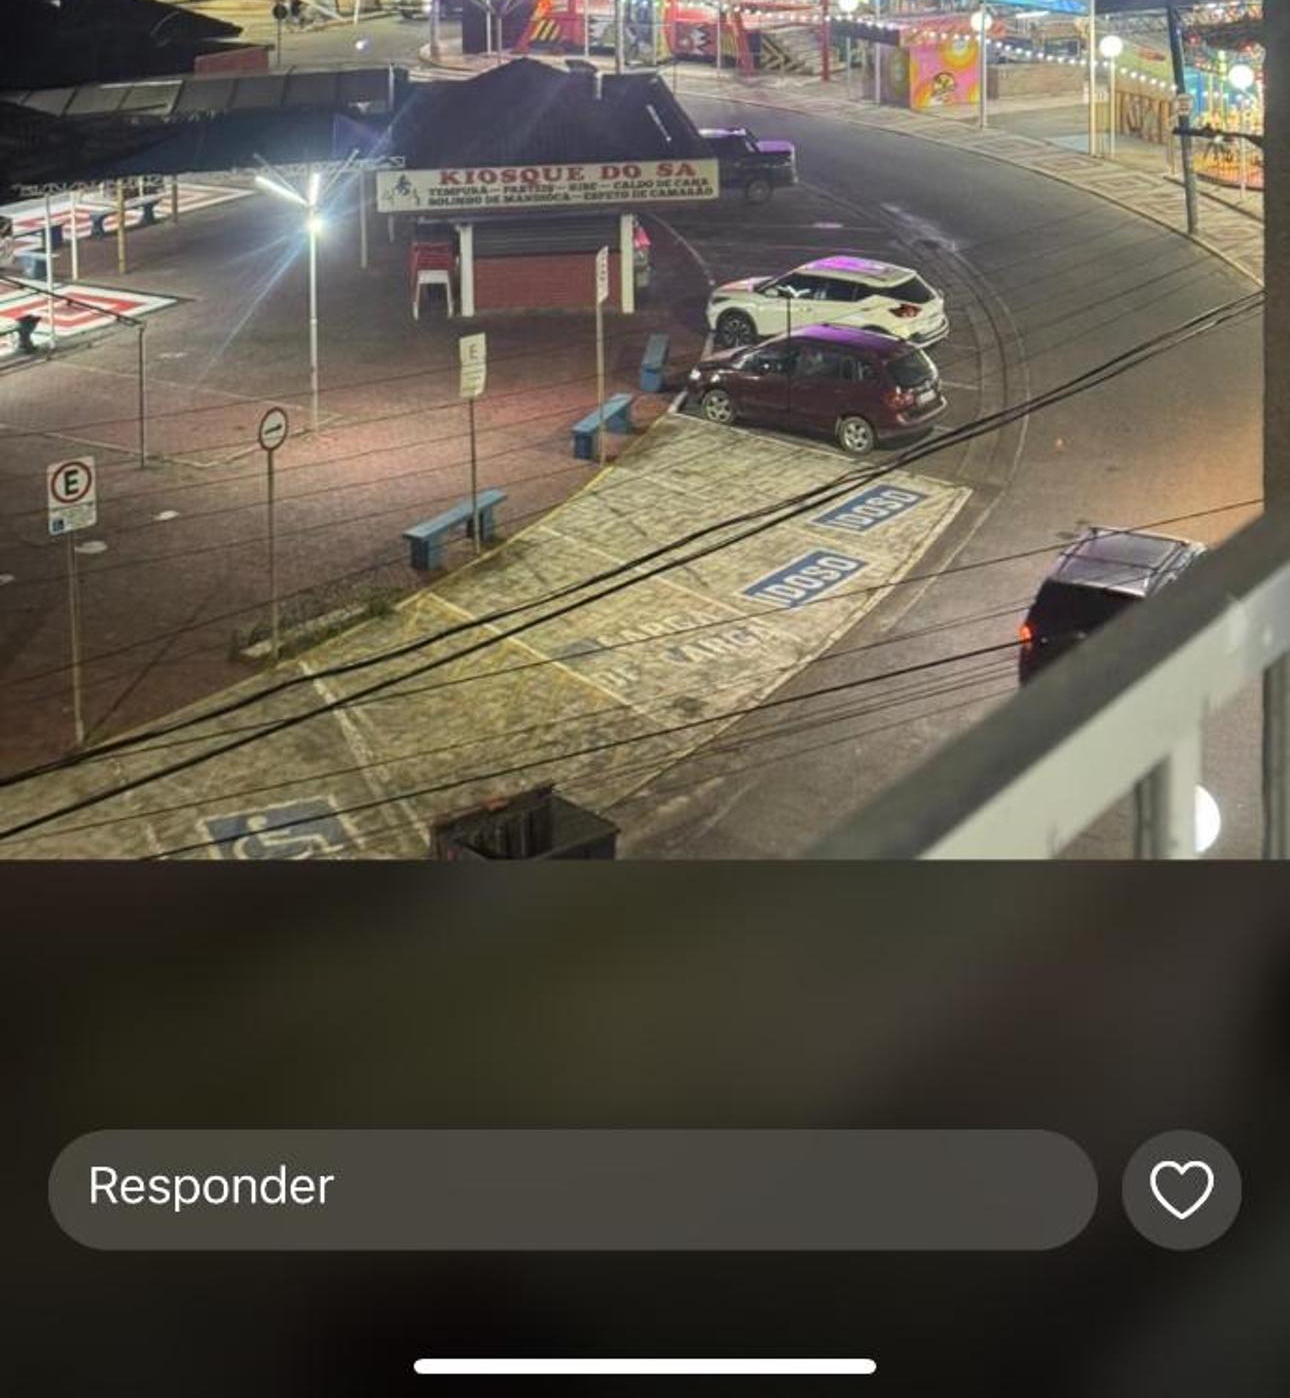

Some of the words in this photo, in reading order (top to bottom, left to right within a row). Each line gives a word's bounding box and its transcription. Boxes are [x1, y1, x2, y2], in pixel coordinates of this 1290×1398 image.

[439, 166, 585, 186] KIOSQUE
[601, 164, 641, 180] DO
[656, 162, 696, 178] SA
[613, 179, 654, 189] CALDO
[656, 178, 671, 187] DE
[485, 194, 499, 204] DE
[632, 189, 648, 199] DE
[64, 468, 80, 496] E
[826, 488, 921, 531] IDOSO
[753, 555, 860, 608] IDOSO
